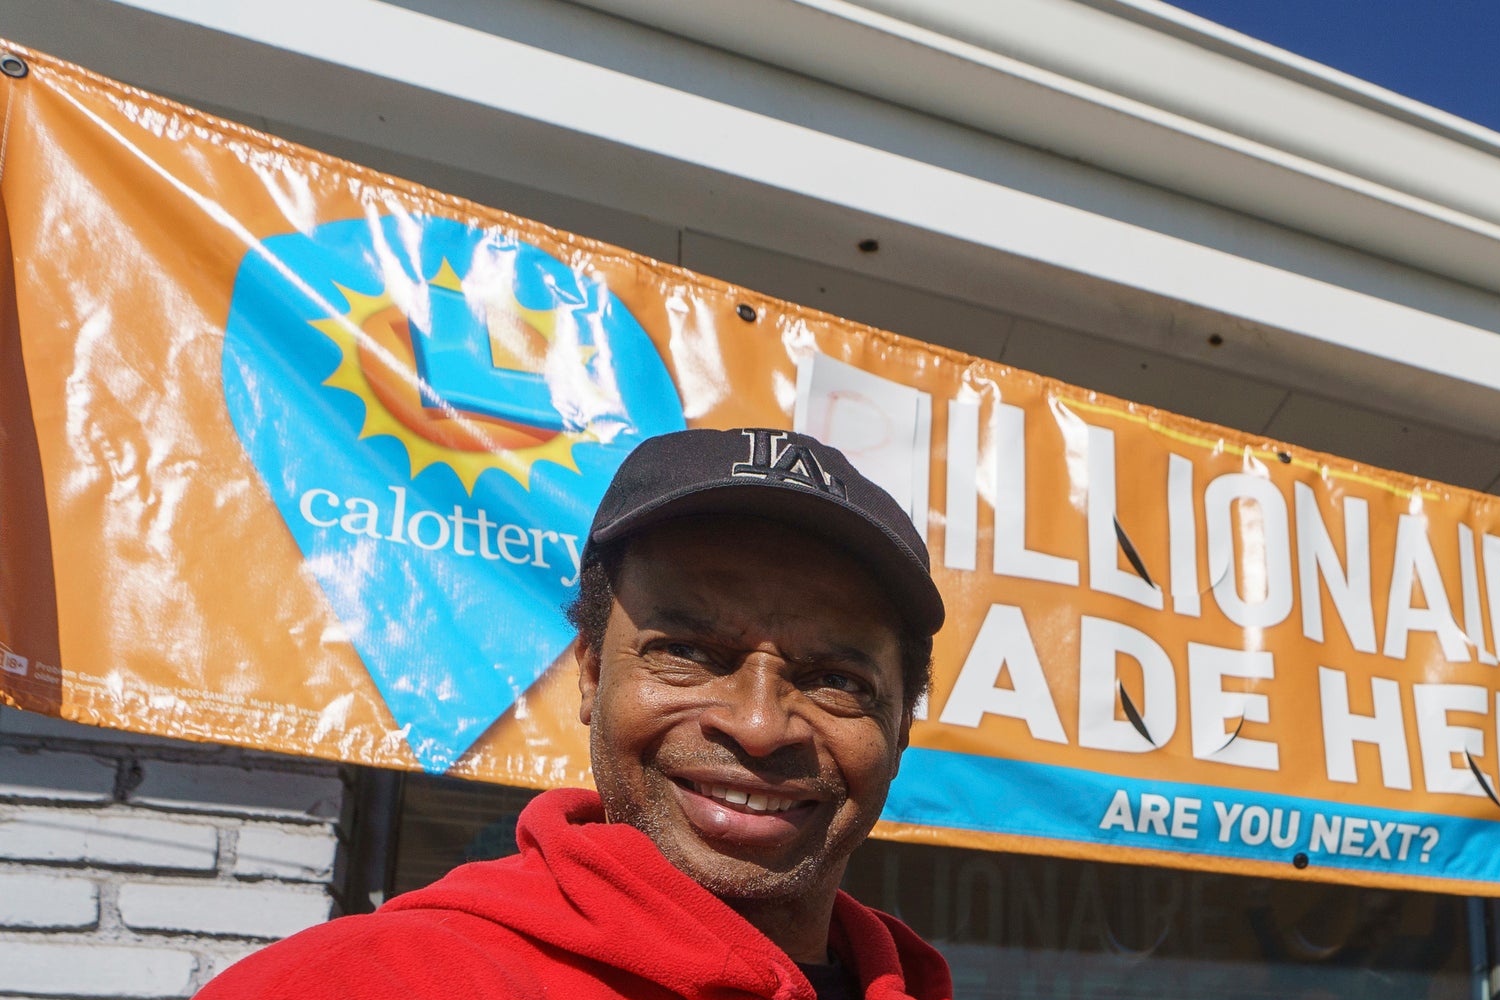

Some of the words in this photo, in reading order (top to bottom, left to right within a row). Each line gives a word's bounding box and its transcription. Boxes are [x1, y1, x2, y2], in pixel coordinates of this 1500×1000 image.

[732, 428, 848, 501] LA
[300, 486, 584, 587] calottery
[903, 604, 1279, 771] ADE
[1099, 790, 1200, 840] ARE
[1213, 800, 1302, 849] YOU
[1308, 813, 1439, 865] NEXT?
